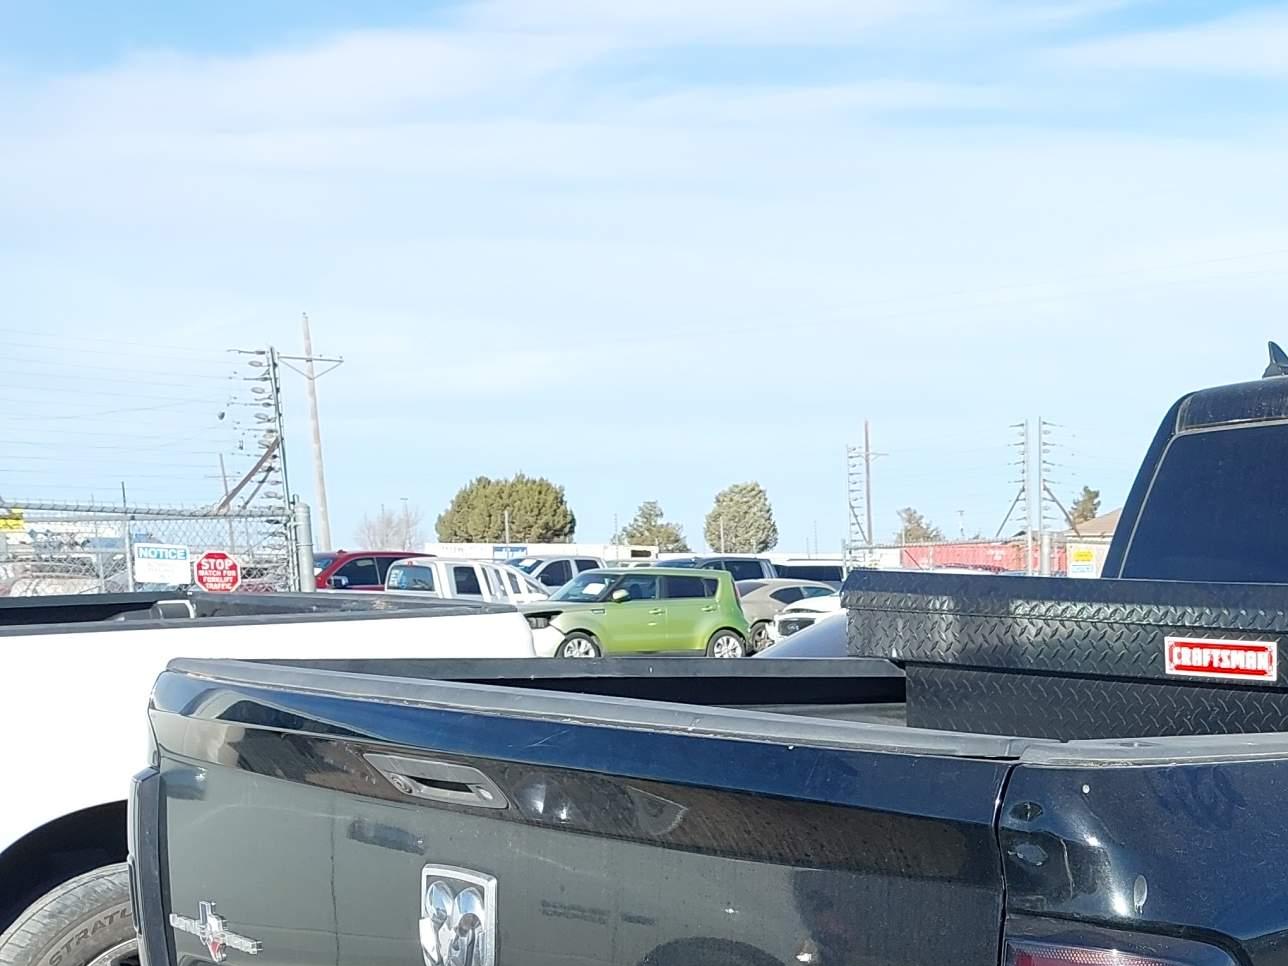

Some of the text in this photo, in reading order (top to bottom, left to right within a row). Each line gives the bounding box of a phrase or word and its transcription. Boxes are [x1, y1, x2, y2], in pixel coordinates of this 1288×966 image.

[139, 547, 186, 559] NOTICE
[201, 558, 233, 570] STOP
[1172, 646, 1269, 670] CRAFTSMAN
